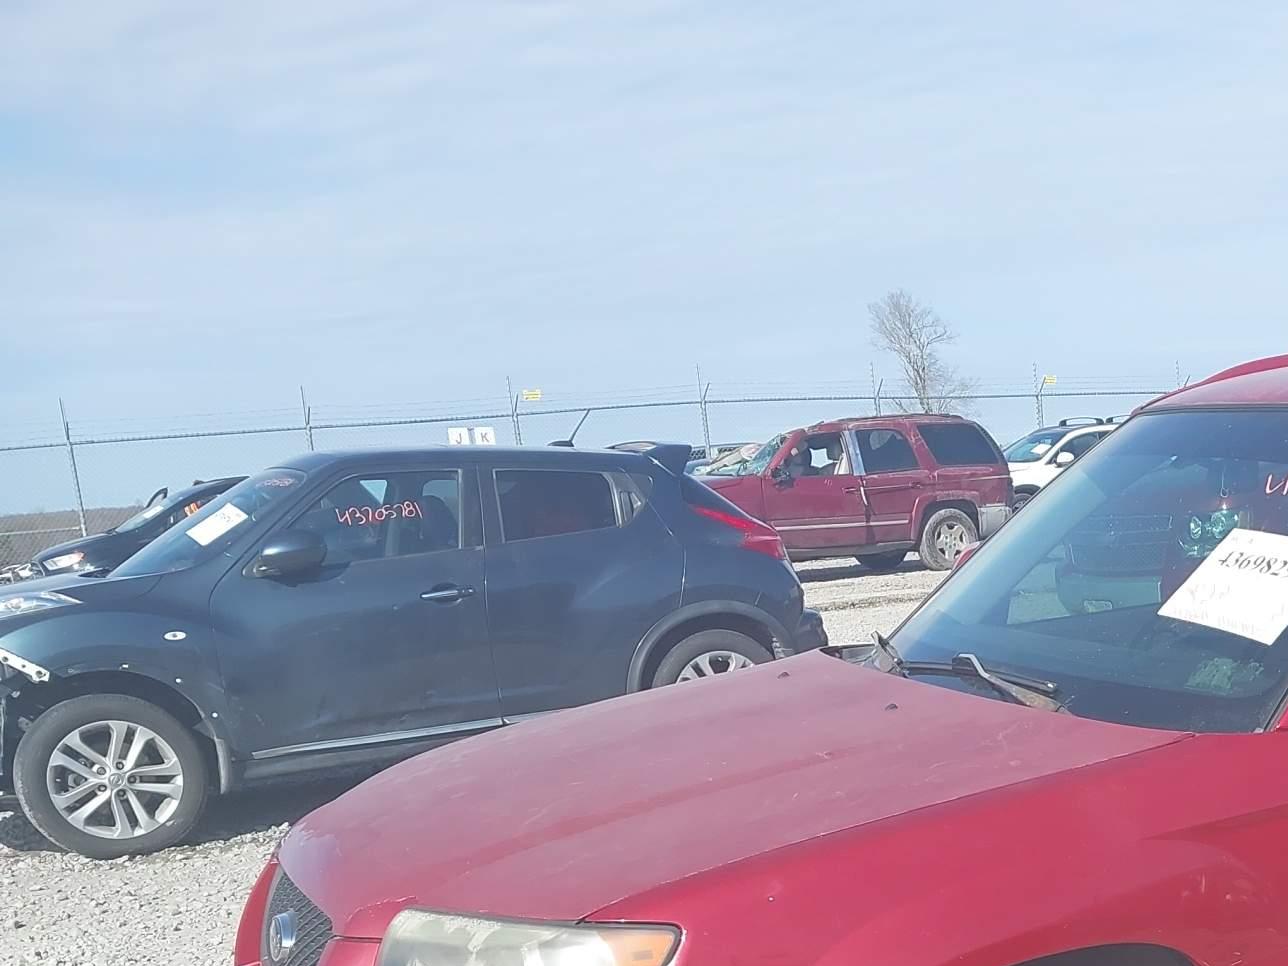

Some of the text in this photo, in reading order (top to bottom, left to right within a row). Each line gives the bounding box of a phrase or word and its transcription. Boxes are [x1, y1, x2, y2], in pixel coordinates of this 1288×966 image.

[455, 432, 463, 444] J
[480, 431, 490, 443] K
[334, 500, 424, 526] 43705781
